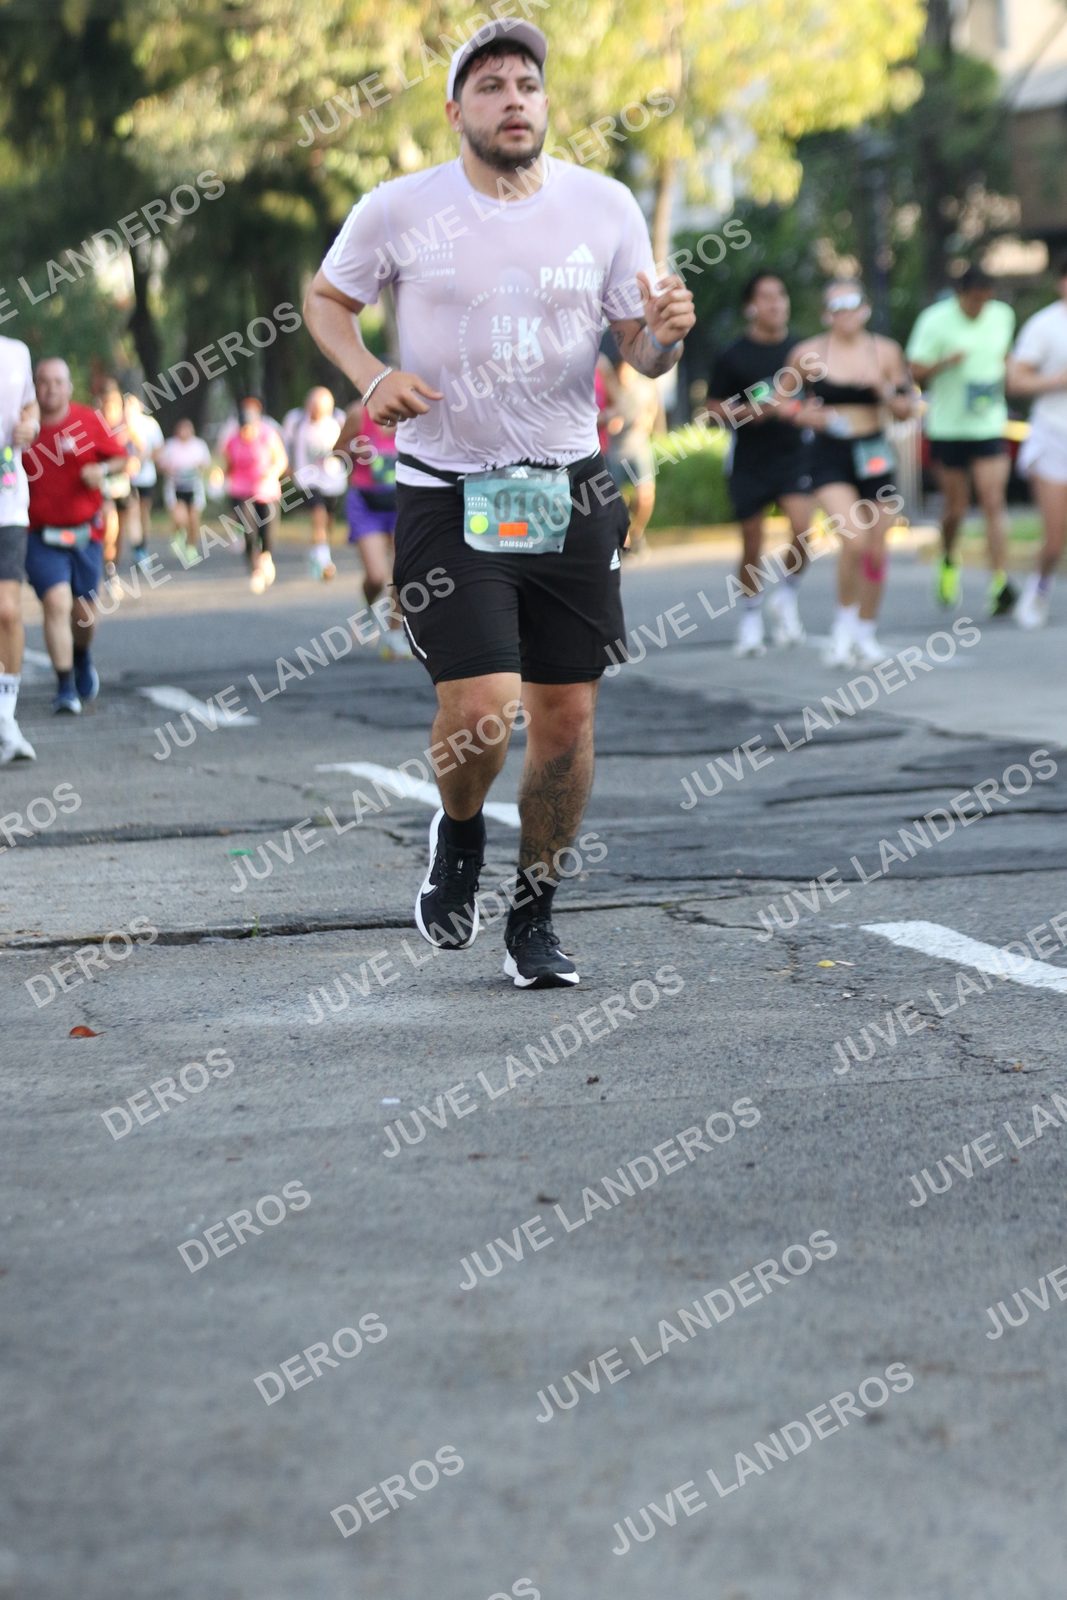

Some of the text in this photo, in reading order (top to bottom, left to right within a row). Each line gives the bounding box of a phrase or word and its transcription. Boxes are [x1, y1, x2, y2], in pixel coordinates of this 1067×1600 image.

[490, 315, 512, 334] 15
[517, 317, 545, 361] K
[491, 342, 513, 361] 30
[499, 540, 534, 549] SAMSUNG
